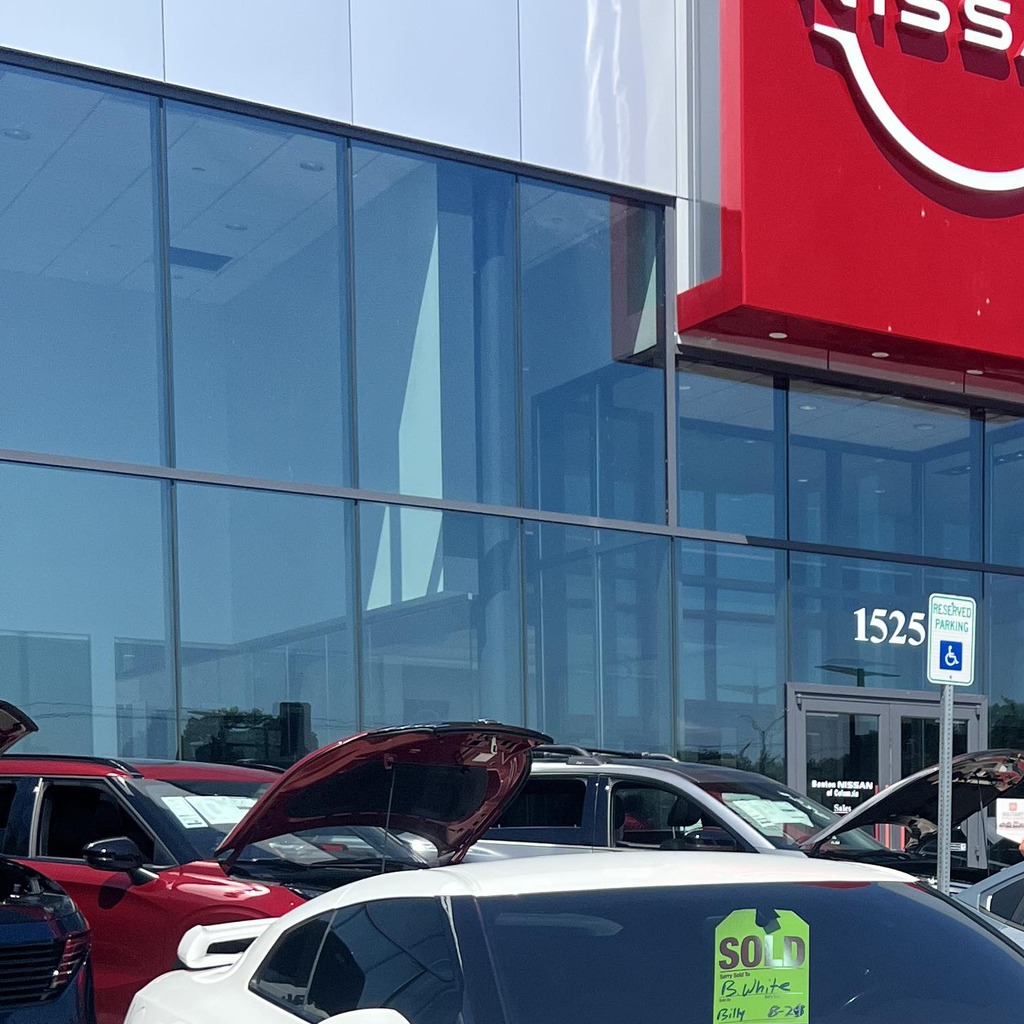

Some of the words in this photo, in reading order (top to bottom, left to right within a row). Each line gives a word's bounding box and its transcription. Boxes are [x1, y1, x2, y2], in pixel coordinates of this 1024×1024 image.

[933, 603, 971, 618] RESERVED
[853, 607, 926, 646] 1525
[935, 619, 968, 632] PARKING
[837, 781, 873, 789] NISSAN
[833, 804, 852, 812] Sales
[719, 935, 805, 970] SOLD
[742, 977, 791, 997] White
[717, 1007, 746, 1021] Billy
